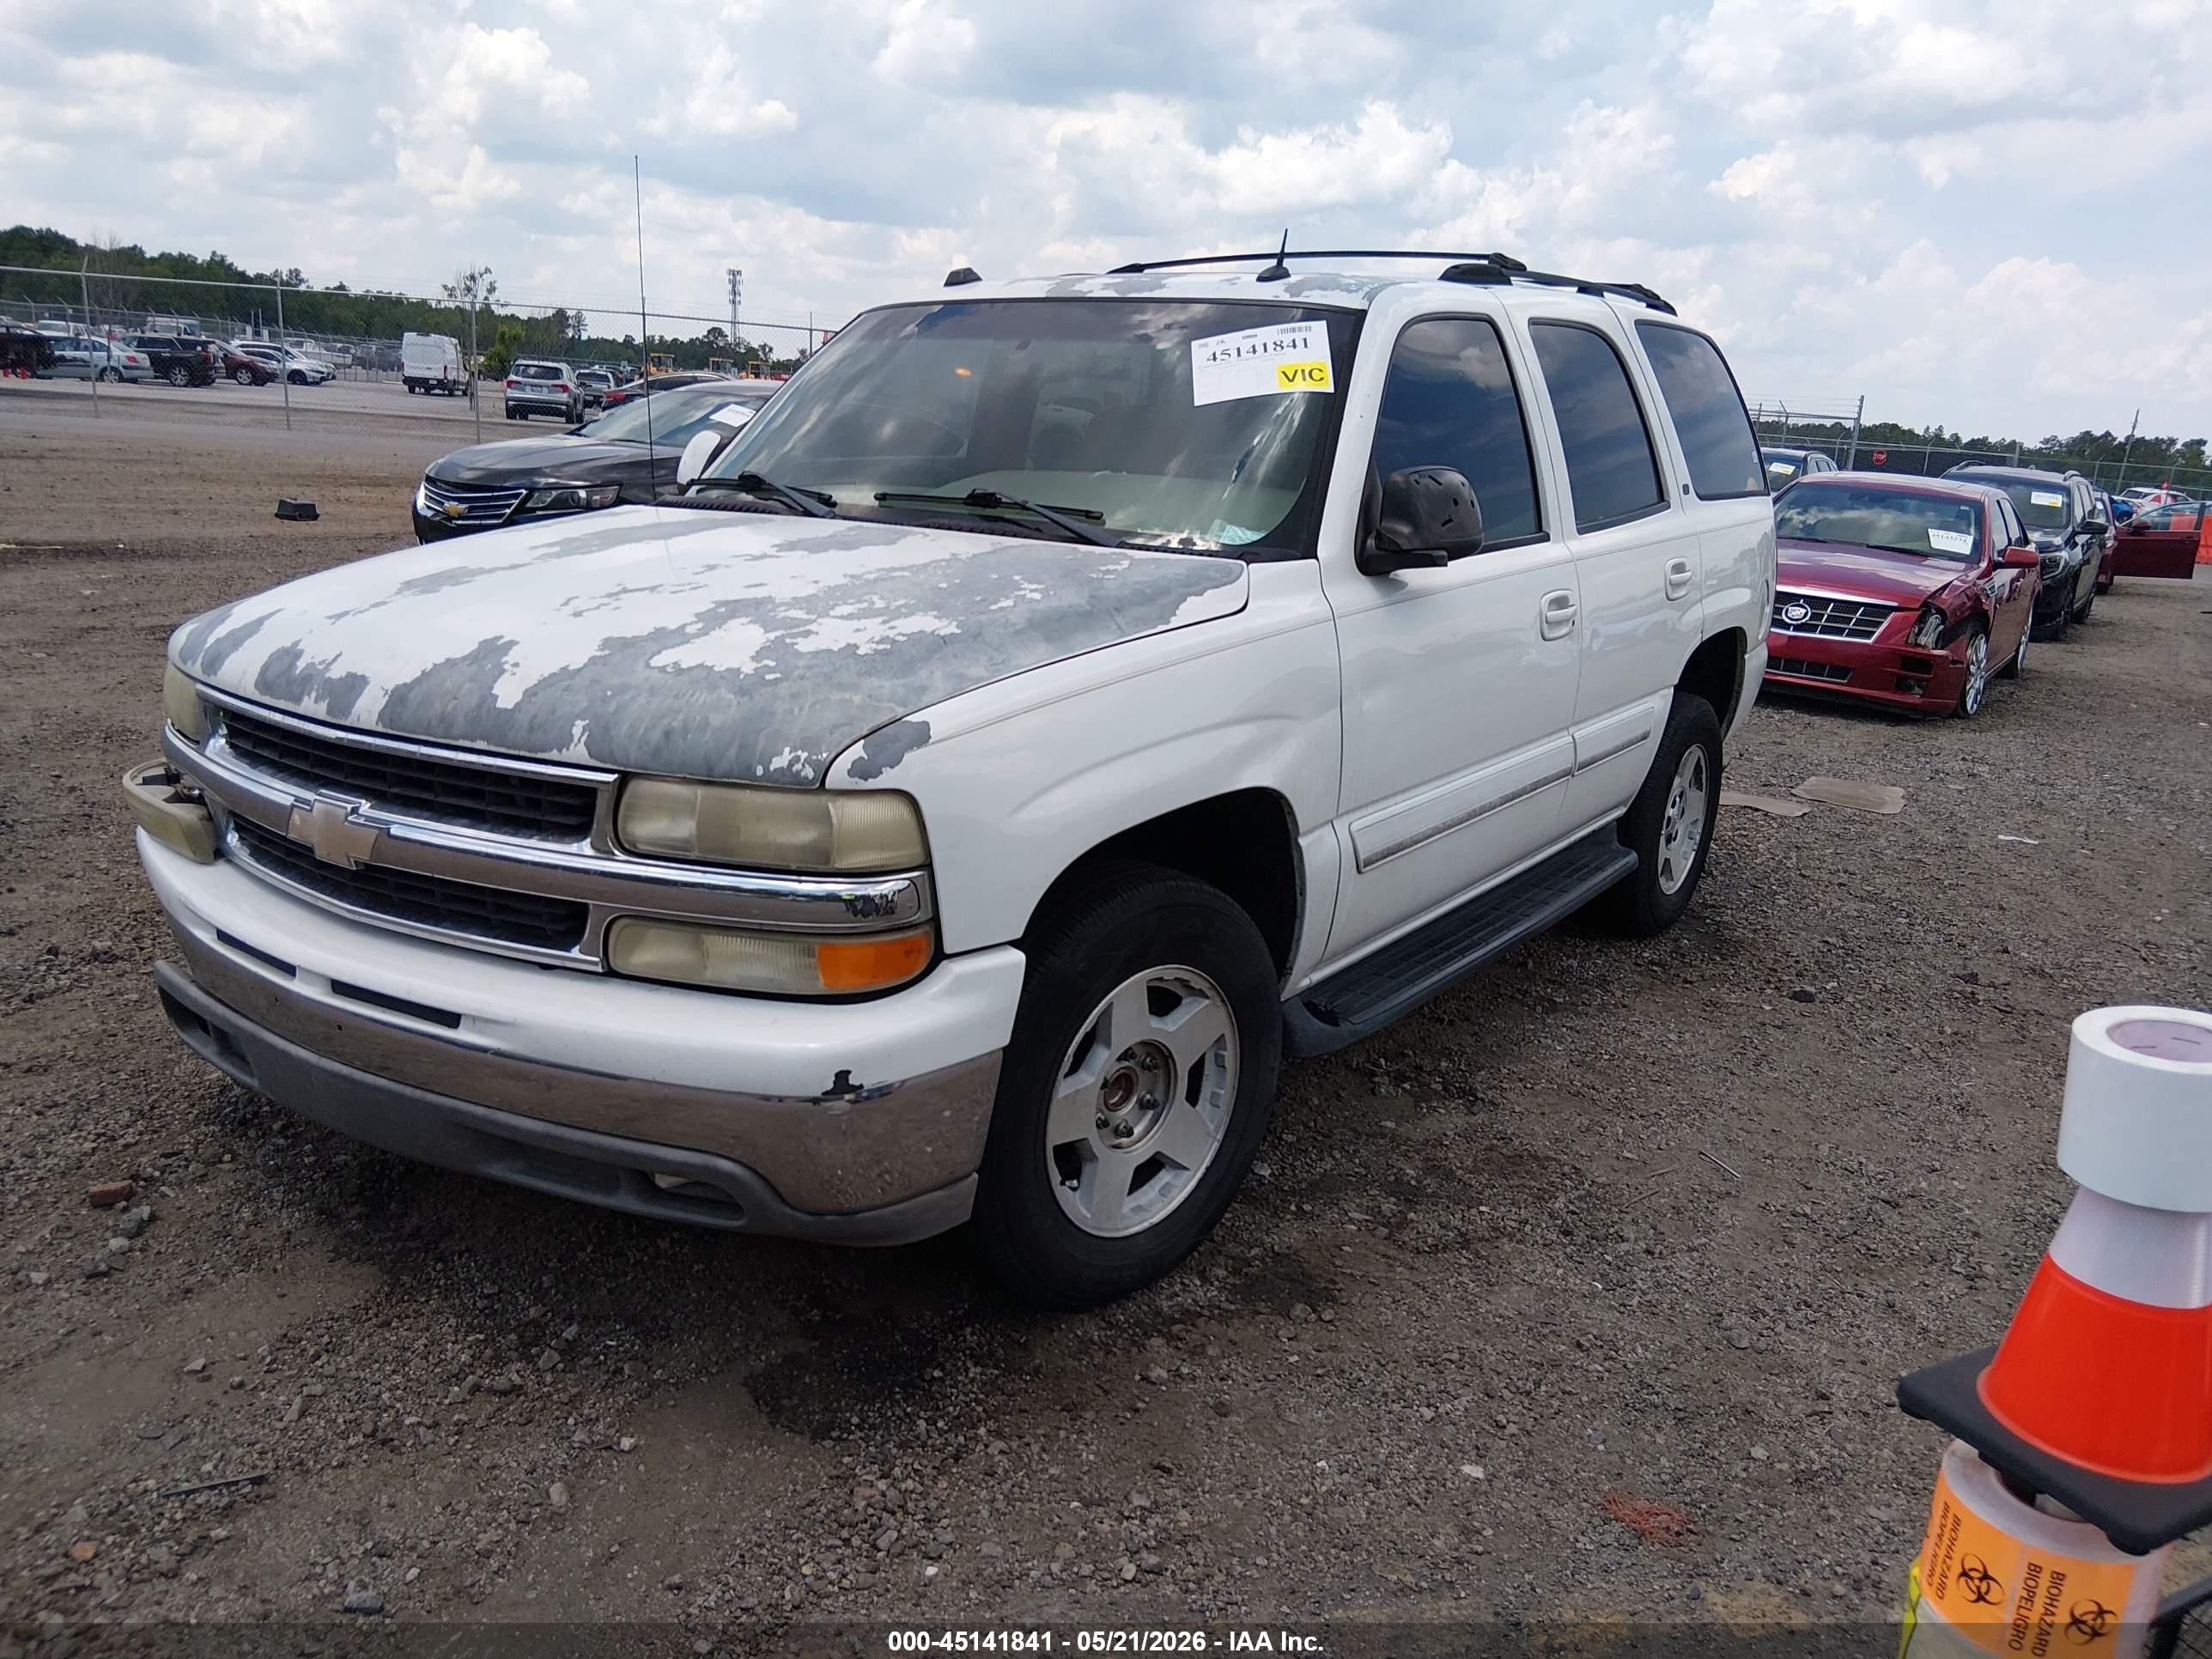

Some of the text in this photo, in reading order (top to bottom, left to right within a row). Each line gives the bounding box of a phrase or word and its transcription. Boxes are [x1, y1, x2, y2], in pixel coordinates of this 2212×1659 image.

[1206, 337, 1309, 362] 45141841
[1281, 368, 1325, 383] VIC
[1926, 1501, 1951, 1588] BIOPELIGRO
[1936, 1513, 1962, 1601] BIOHAZARD
[2008, 1561, 2043, 1651] BIOPELIGRO
[2031, 1570, 2067, 1657] BIOHAZARD
